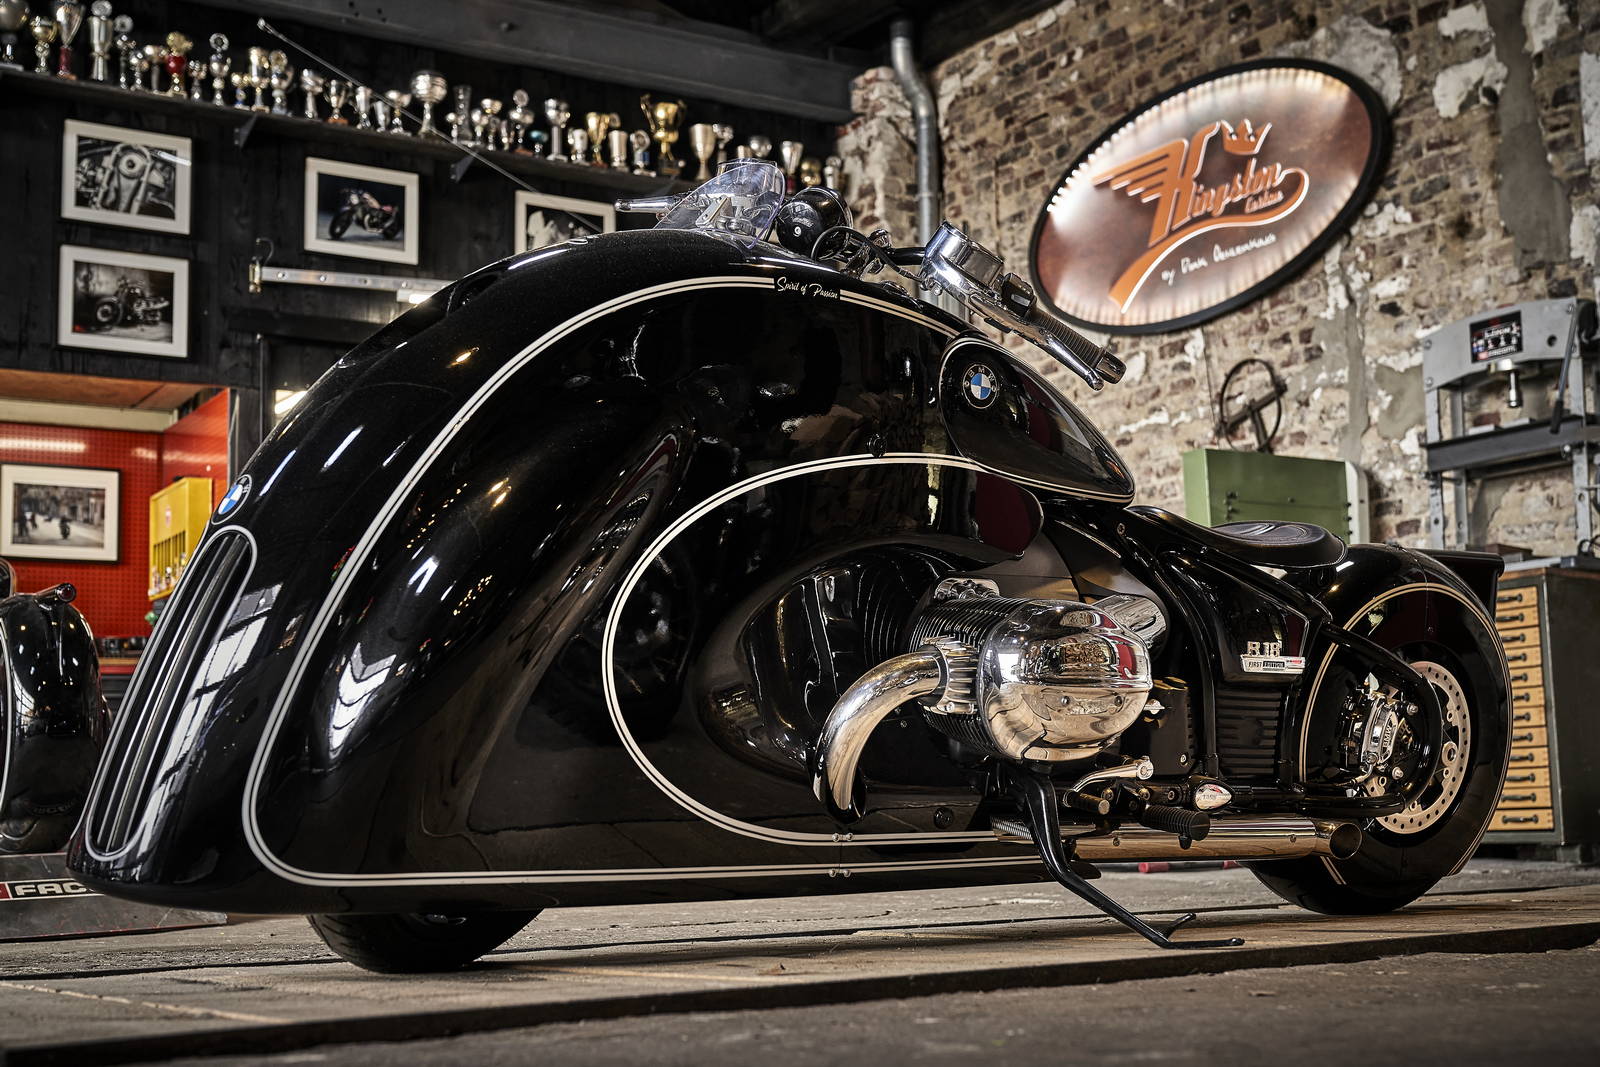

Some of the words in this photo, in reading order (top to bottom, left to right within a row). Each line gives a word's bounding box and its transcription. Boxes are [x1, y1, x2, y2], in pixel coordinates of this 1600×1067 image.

[1092, 121, 1283, 247] Kingston
[777, 276, 800, 291] Spirit
[801, 284, 808, 296] of
[809, 283, 838, 299] Passion
